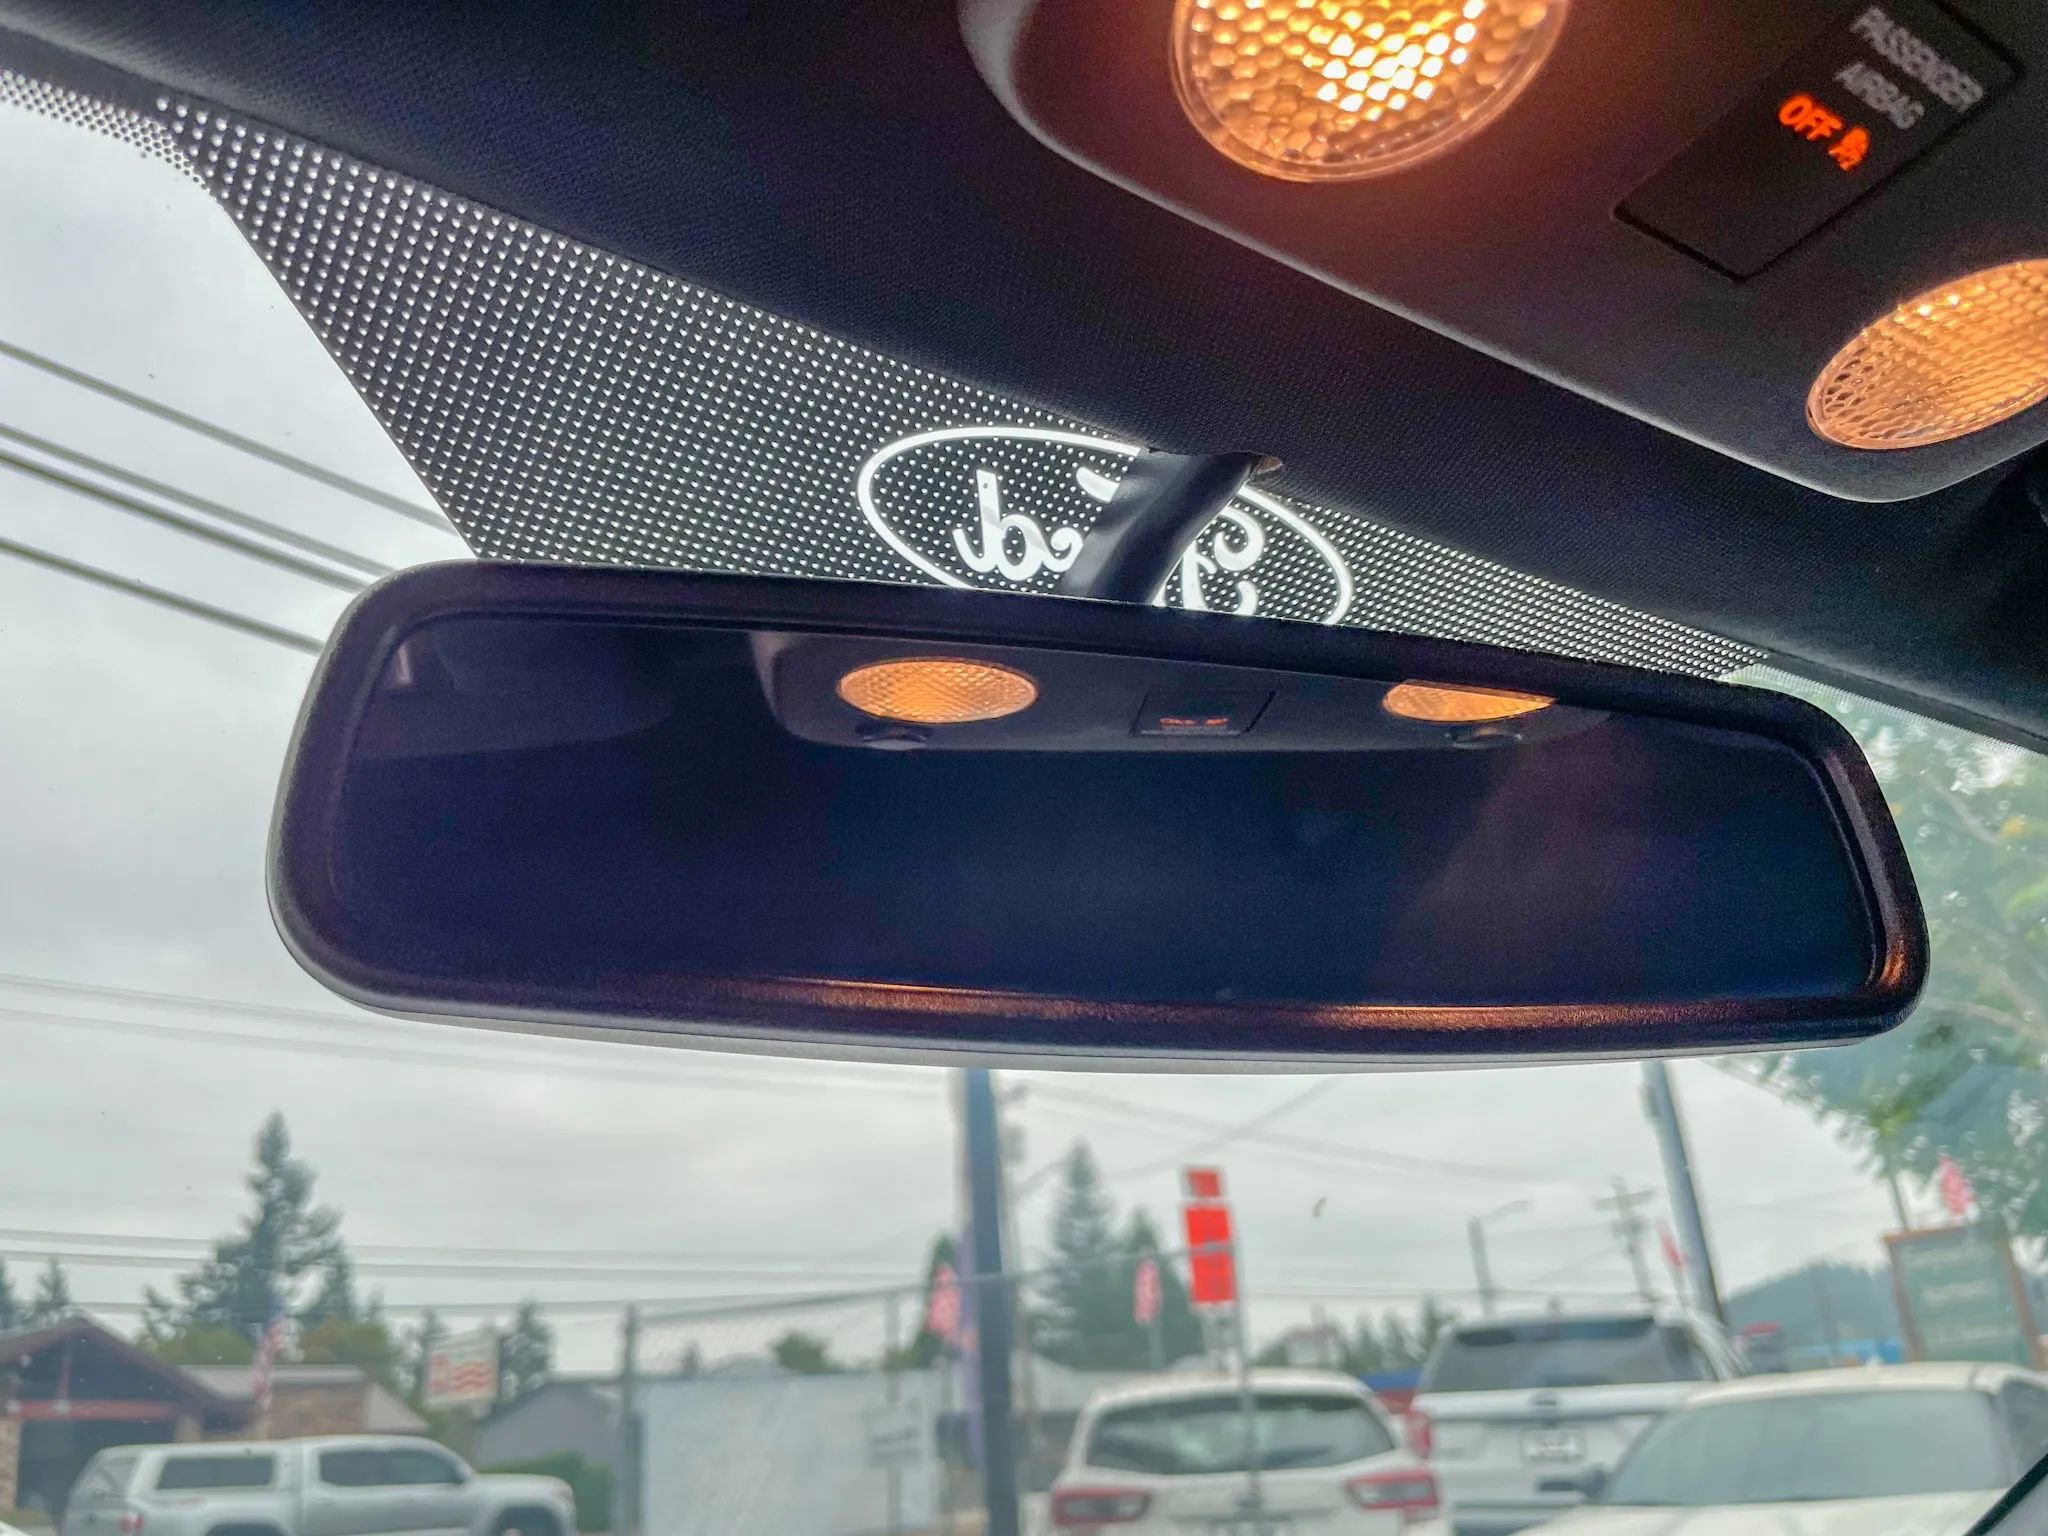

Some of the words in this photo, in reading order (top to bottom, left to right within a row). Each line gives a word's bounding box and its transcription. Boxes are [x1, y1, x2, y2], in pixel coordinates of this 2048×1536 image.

[1849, 5, 1984, 112] PASSENGER
[1779, 93, 1843, 141] OFF
[1833, 61, 1925, 129] AIRBAG
